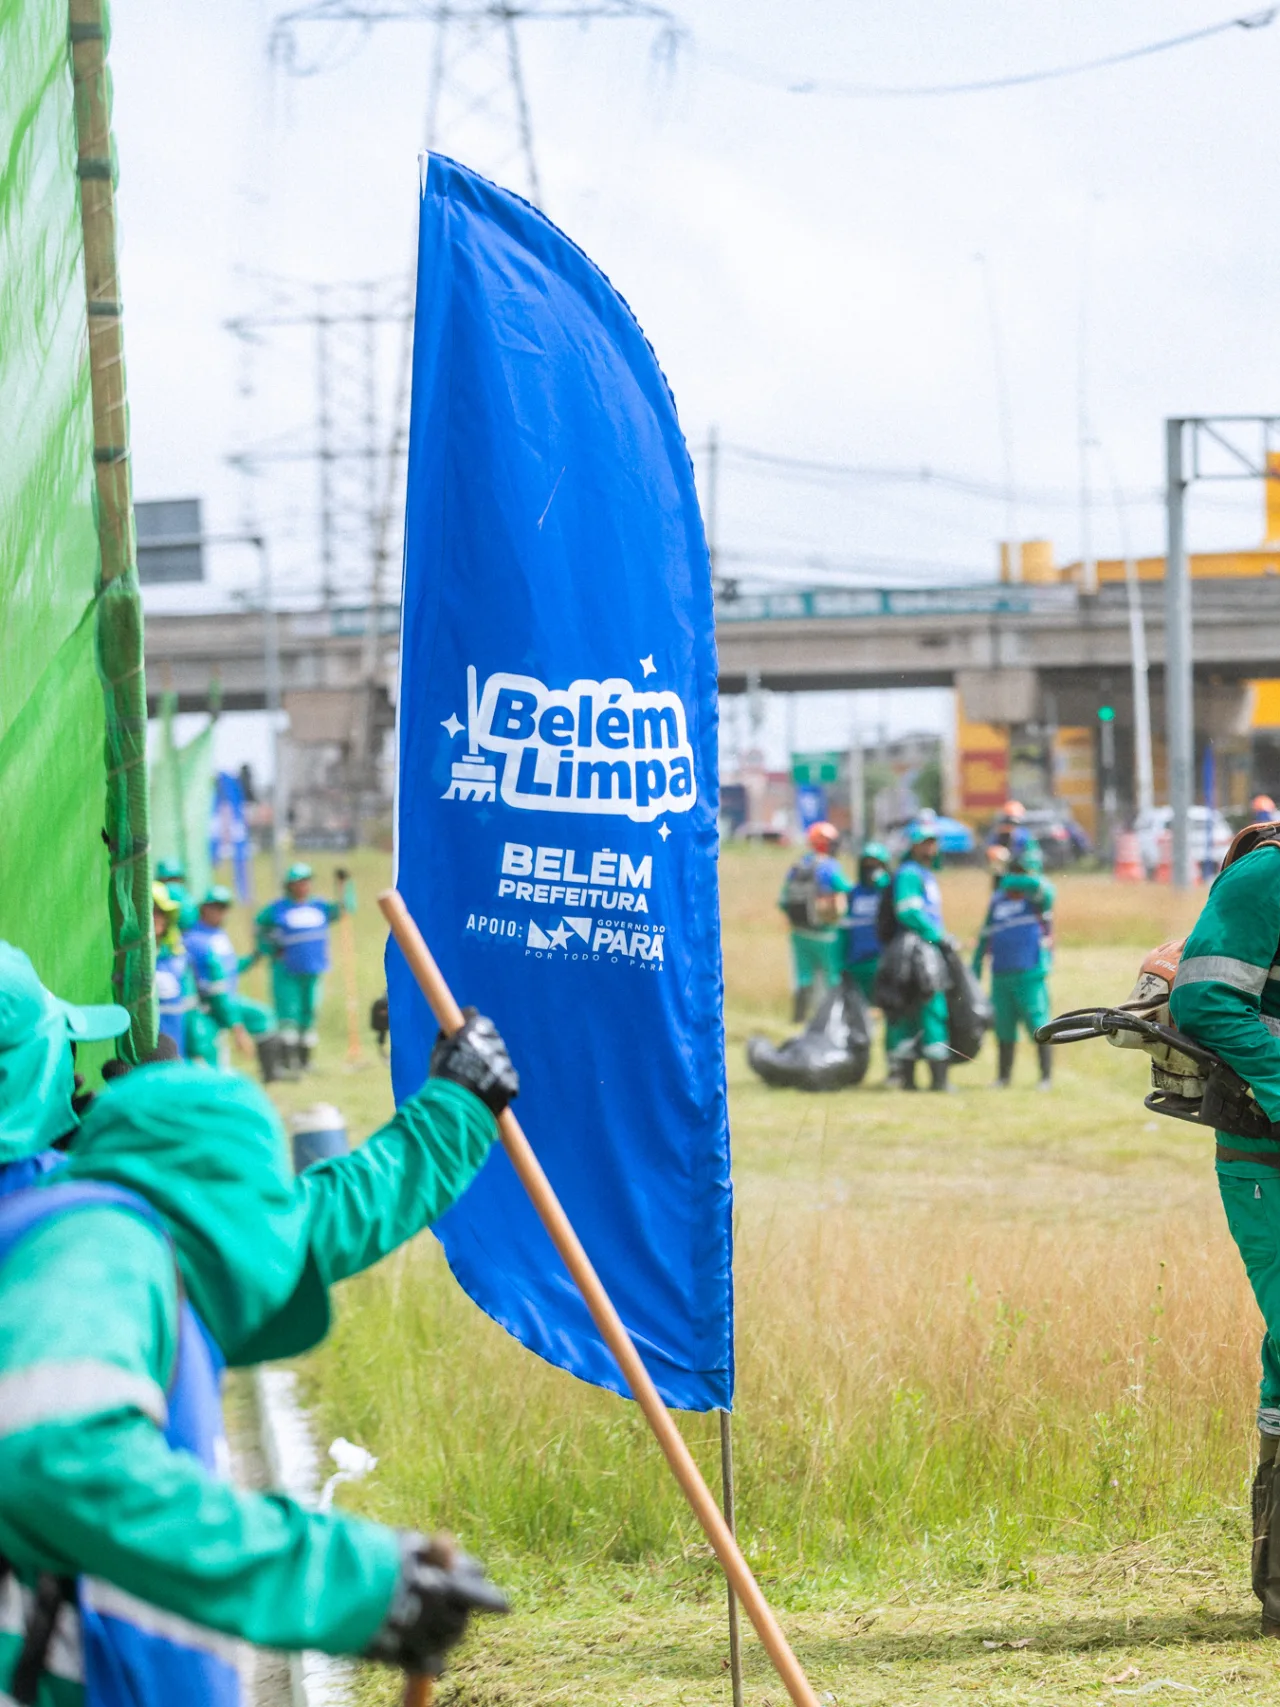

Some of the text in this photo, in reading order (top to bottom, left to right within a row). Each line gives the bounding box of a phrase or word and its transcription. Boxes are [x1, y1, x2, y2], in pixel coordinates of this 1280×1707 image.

[489, 688, 679, 749] Belém
[515, 747, 692, 807] Limpa
[501, 842, 653, 888] BELÉM
[498, 879, 649, 914] PREFEITURA
[466, 913, 523, 938] APOIO:
[597, 919, 666, 933] GOVERNO DO
[525, 949, 664, 972] POR TODO O PARÁ
